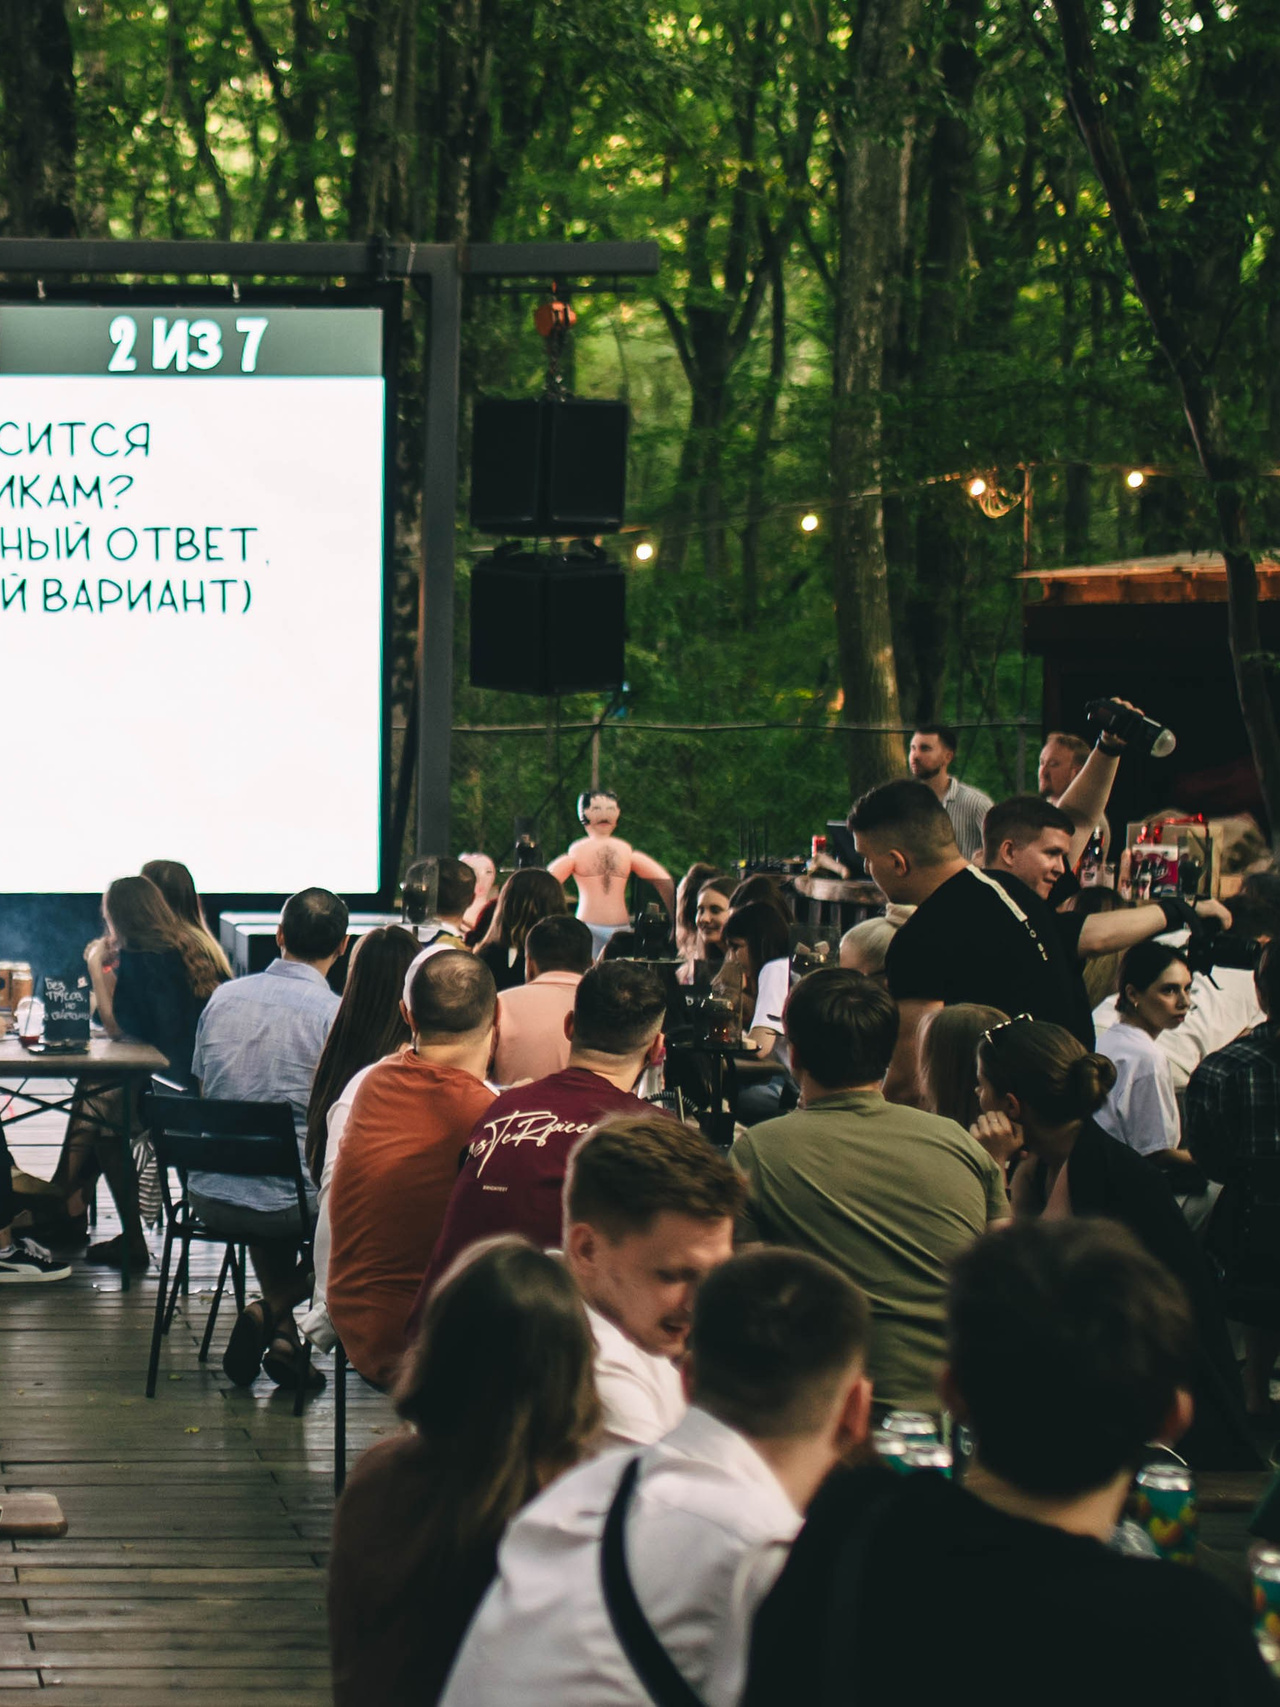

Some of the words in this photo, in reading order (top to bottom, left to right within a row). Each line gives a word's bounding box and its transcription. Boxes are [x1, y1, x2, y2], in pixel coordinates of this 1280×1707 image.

[107, 315, 138, 372] 2
[152, 316, 223, 372] ИЗ
[235, 317, 269, 372] 7
[42, 577, 253, 616] ВАРИАНТ)
